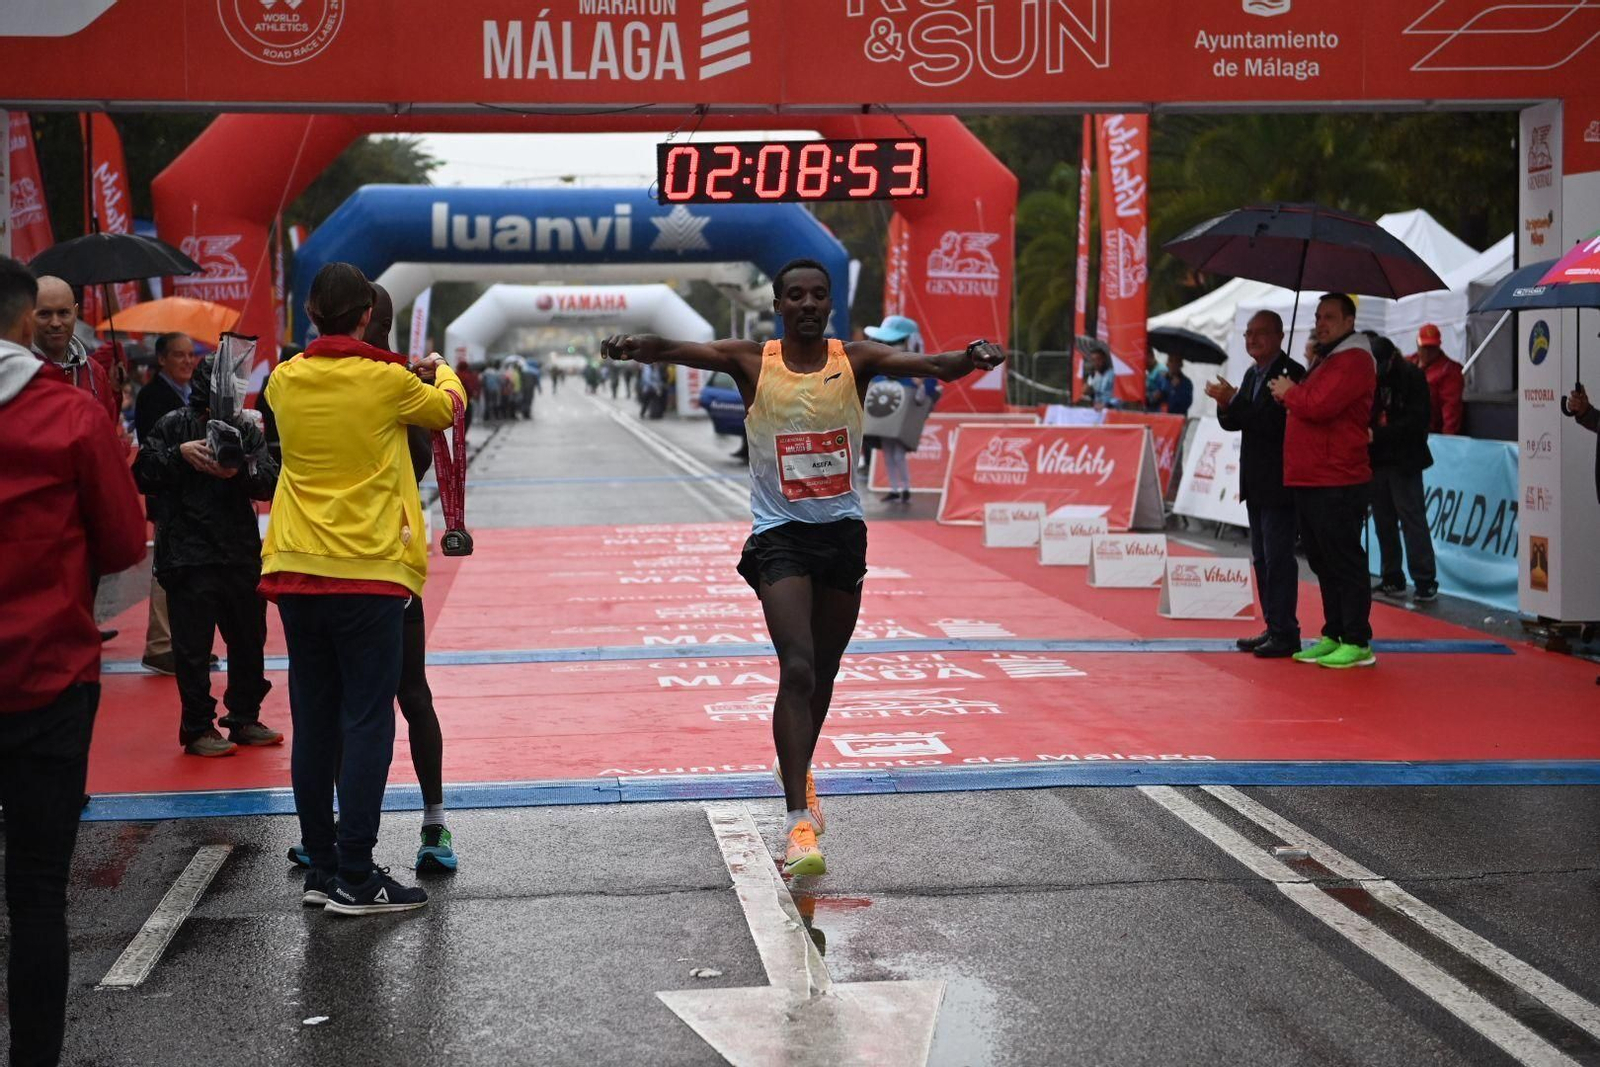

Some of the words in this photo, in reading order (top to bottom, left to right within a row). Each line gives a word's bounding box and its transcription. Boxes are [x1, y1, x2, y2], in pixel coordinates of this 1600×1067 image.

[255, 22, 309, 32] ATHLETICS
[263, 13, 300, 22] WORLD
[262, 48, 292, 59] ROAD
[293, 39, 319, 57] RACE
[316, 13, 338, 41] LABEL
[483, 8, 686, 81] MÁLAGA
[864, 17, 905, 62] &
[908, 0, 1110, 86] SUN
[1195, 30, 1339, 53] Ayuntamiento
[1213, 59, 1238, 77] de
[1244, 57, 1320, 80] Málaga
[664, 143, 924, 200] 02:08:53
[432, 202, 632, 251] luanvi
[925, 280, 998, 296] GENERALI
[557, 294, 627, 311] YAMAHA
[1524, 389, 1554, 401] VICTORIA
[974, 471, 1027, 484] GENERALI
[1036, 438, 1115, 486] Vitality
[1125, 541, 1165, 559] Vitality
[1204, 565, 1248, 589] Vitality
[597, 759, 943, 777] Ayuntaiento
[335, 887, 356, 903] Reebok
